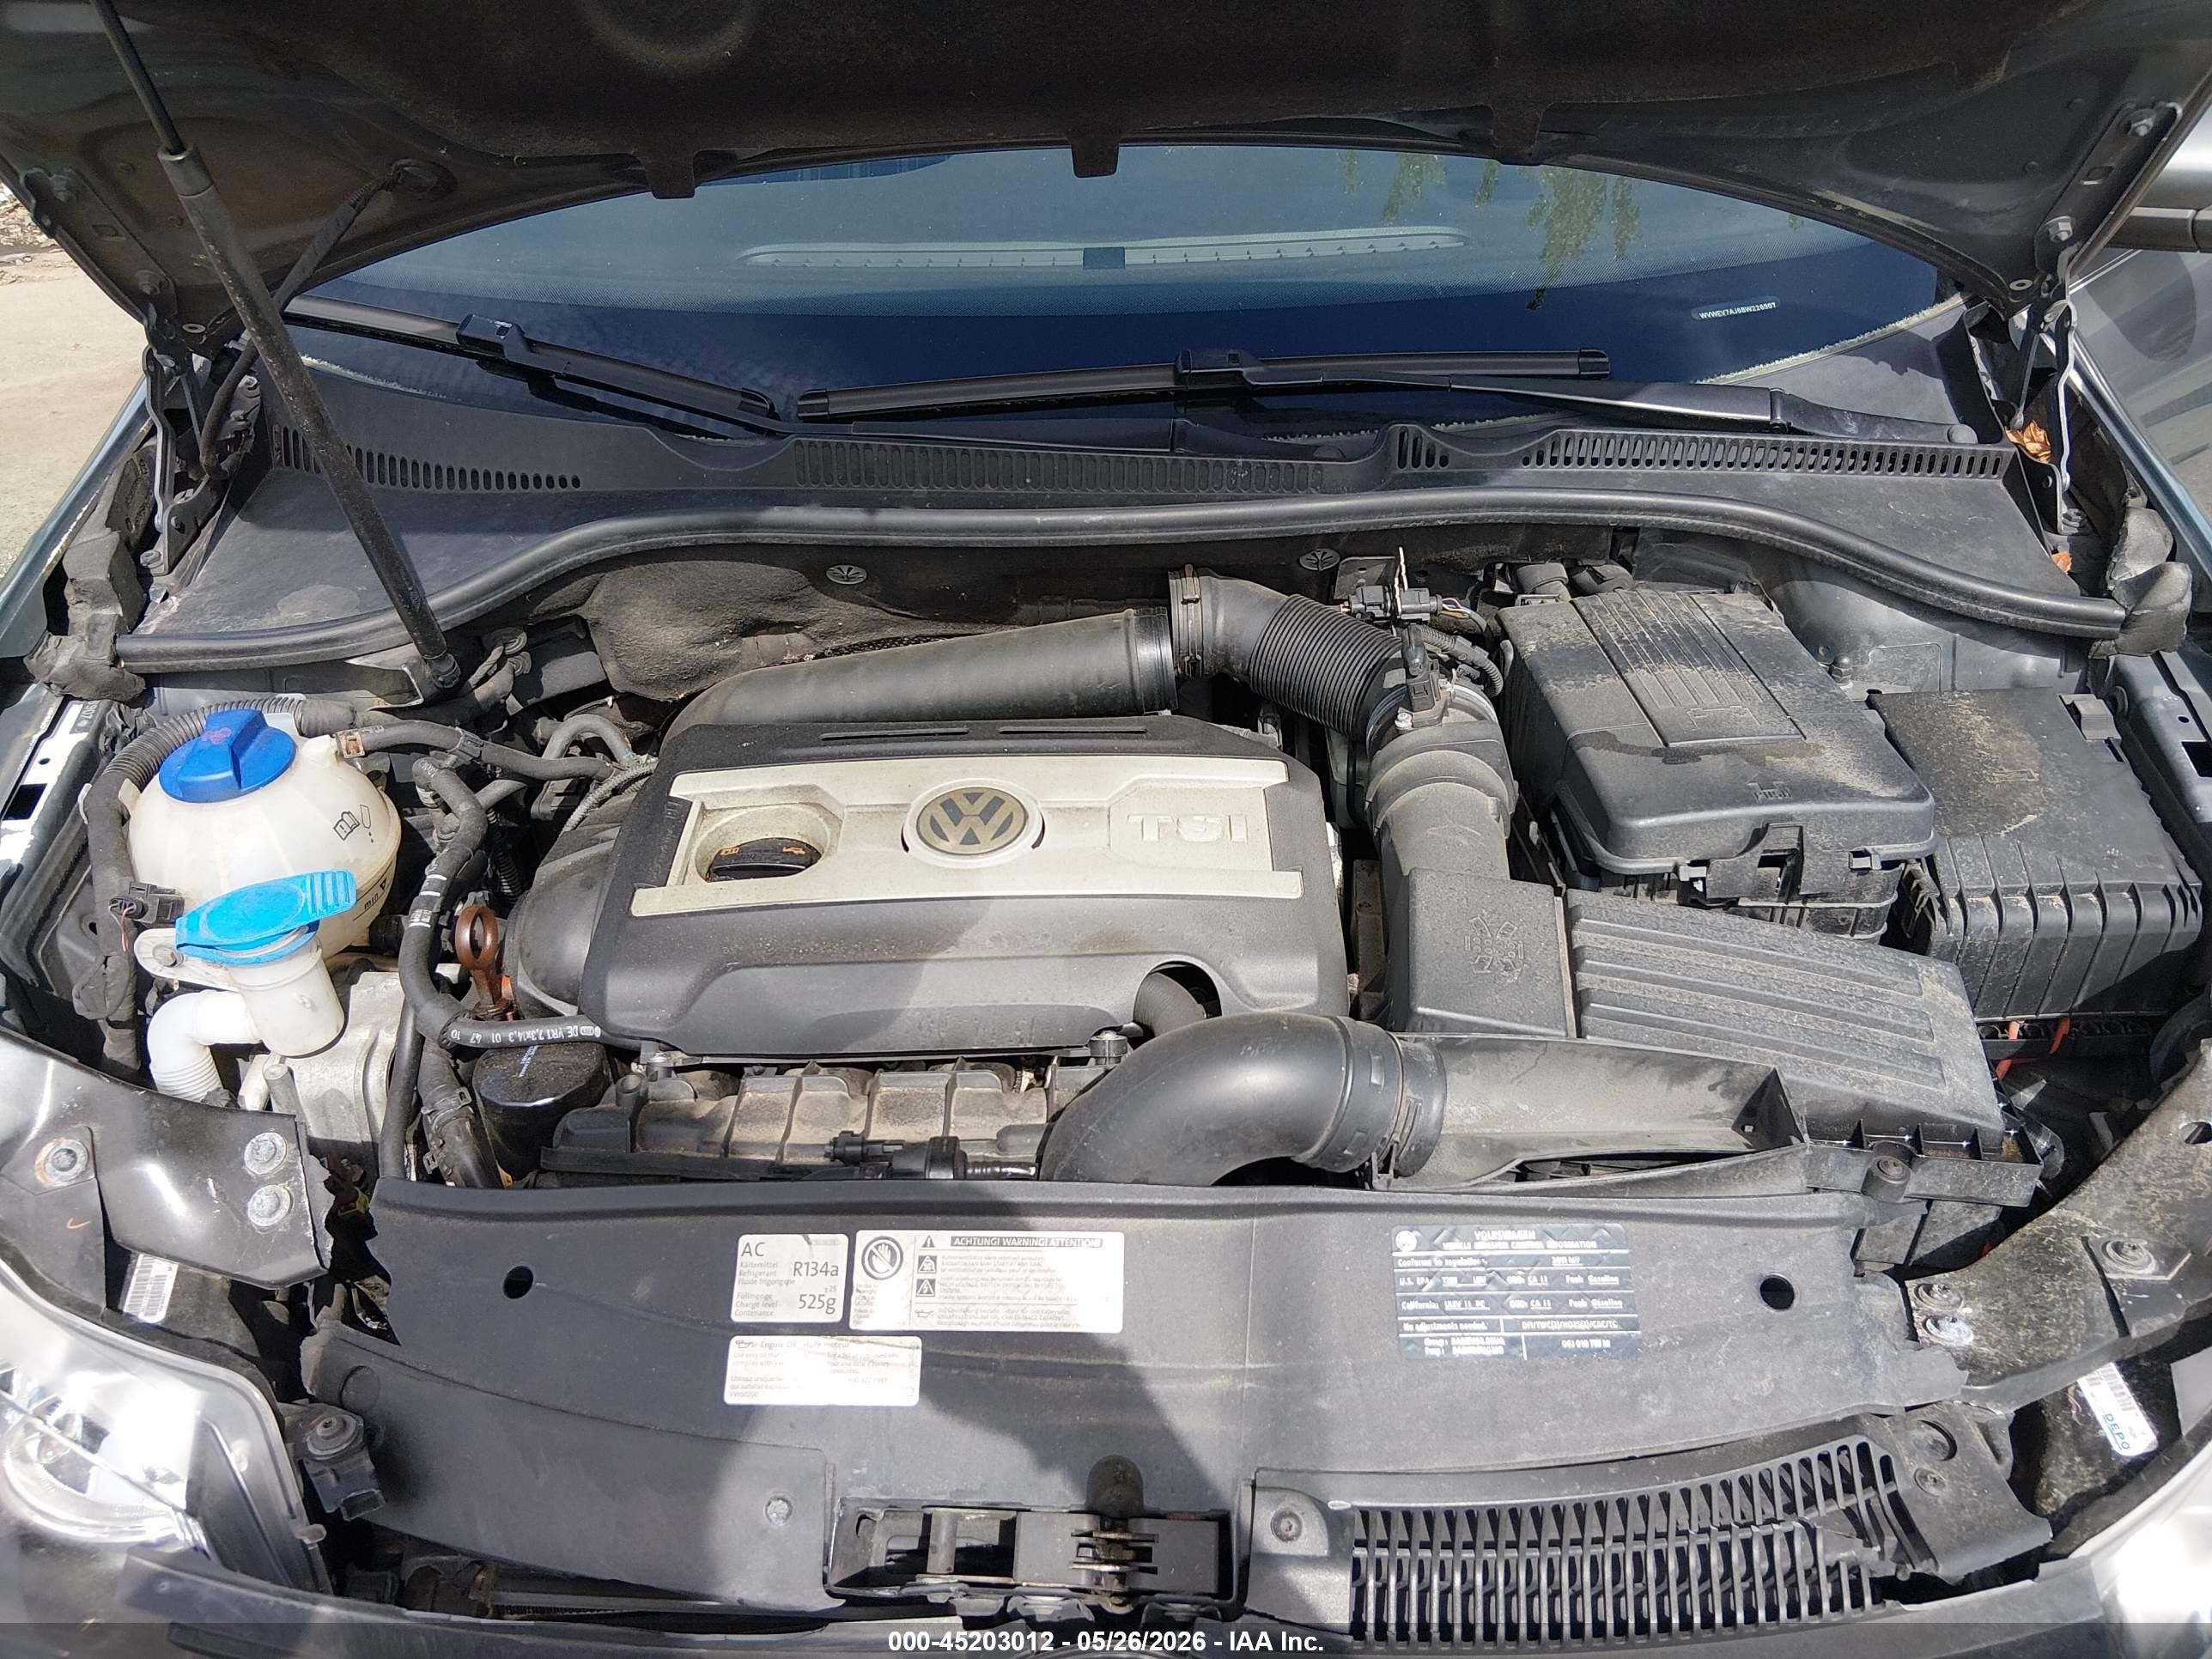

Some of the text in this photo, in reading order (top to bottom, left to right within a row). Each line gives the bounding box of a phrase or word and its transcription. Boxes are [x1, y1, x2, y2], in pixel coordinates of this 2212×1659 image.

[1126, 813, 1249, 843] TSI
[508, 1030, 544, 1043] 7,3x14,3
[546, 1027, 564, 1040] VRT
[567, 1025, 579, 1037] DE
[952, 1237, 1001, 1247] ACHTUNG!
[1002, 1237, 1048, 1247] WARNING!
[741, 1242, 765, 1257] AC
[739, 1269, 776, 1278] Refrigerant
[793, 1261, 839, 1277] R134a
[798, 1293, 837, 1315] 525g
[2105, 1413, 2130, 1449] DEPO
